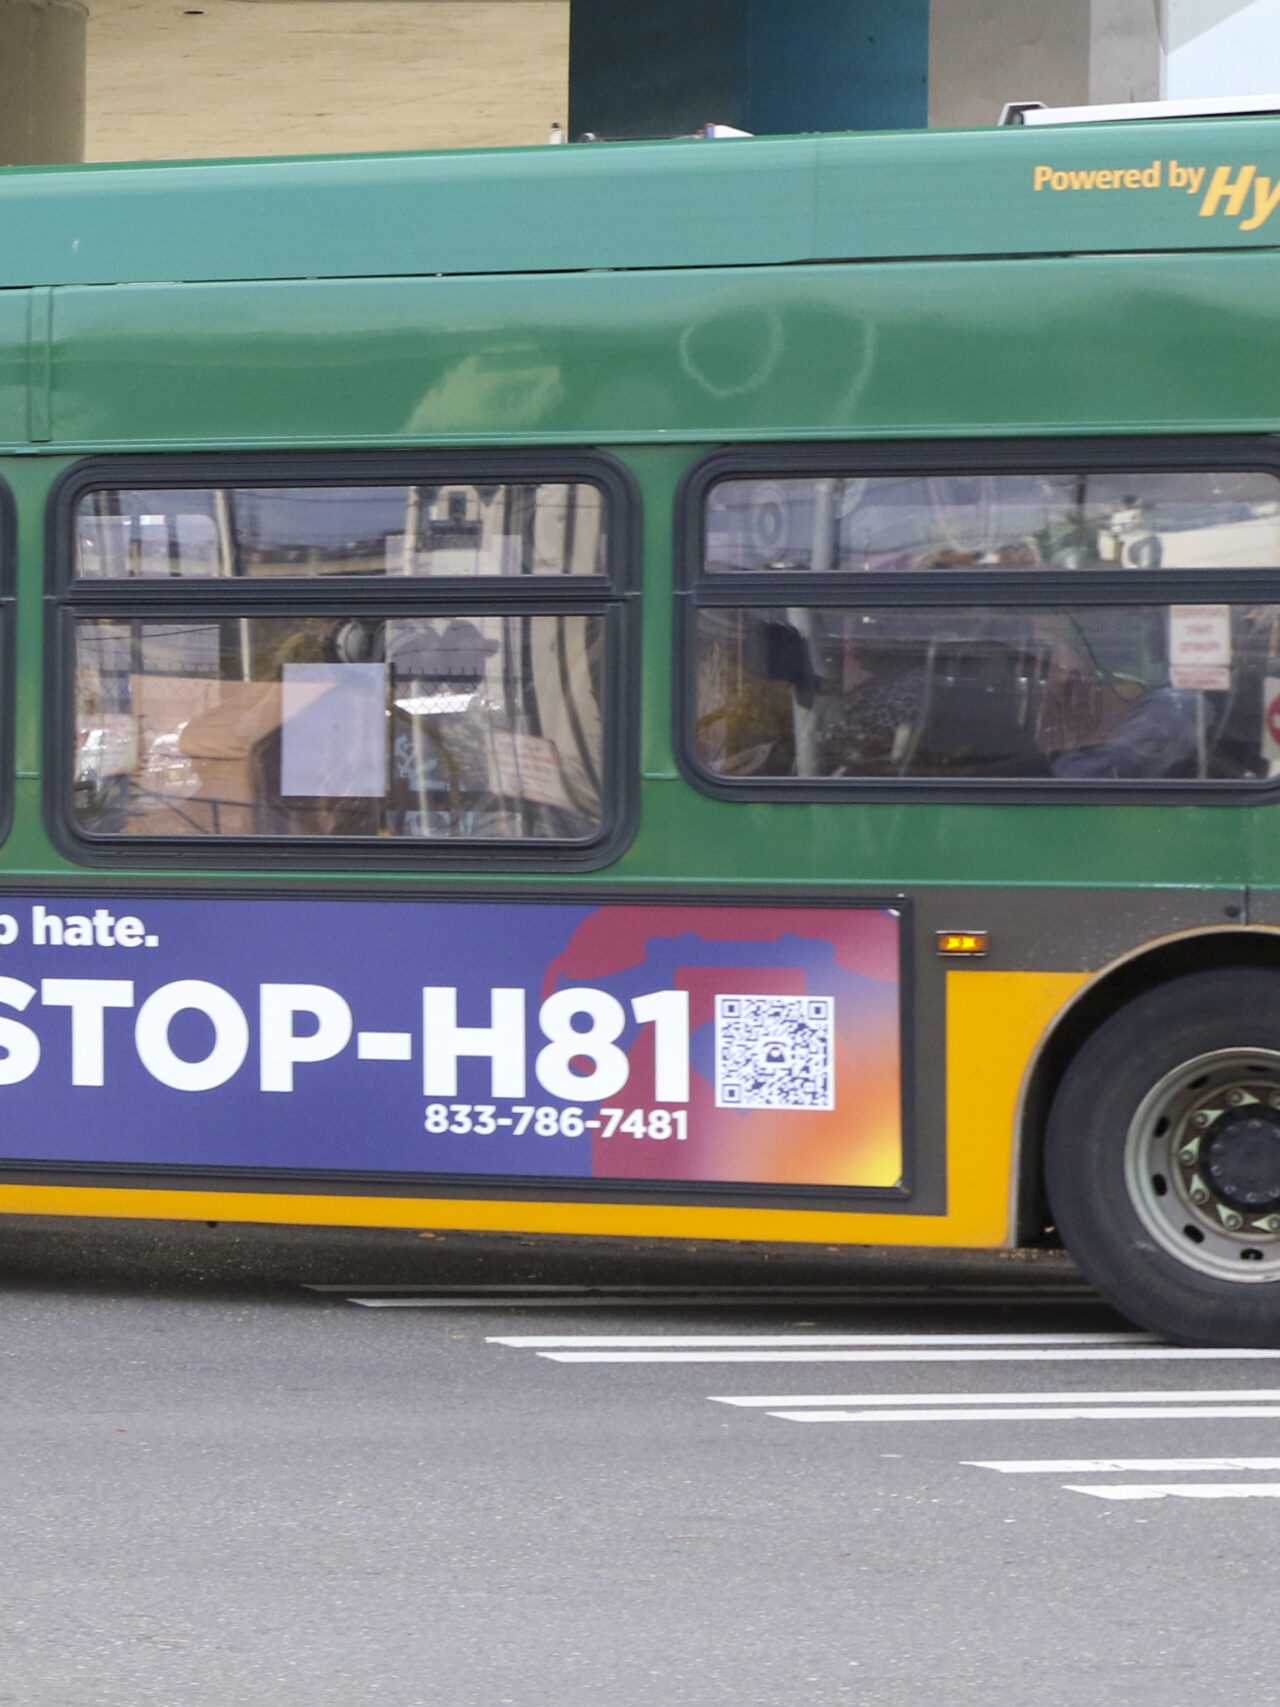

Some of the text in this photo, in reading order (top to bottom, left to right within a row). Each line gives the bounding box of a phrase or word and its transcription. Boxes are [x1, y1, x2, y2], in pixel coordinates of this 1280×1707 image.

[1033, 160, 1162, 191] Powered
[1168, 160, 1206, 194] by
[32, 905, 160, 947] hate.
[424, 1103, 688, 1141] 833-786-7481
